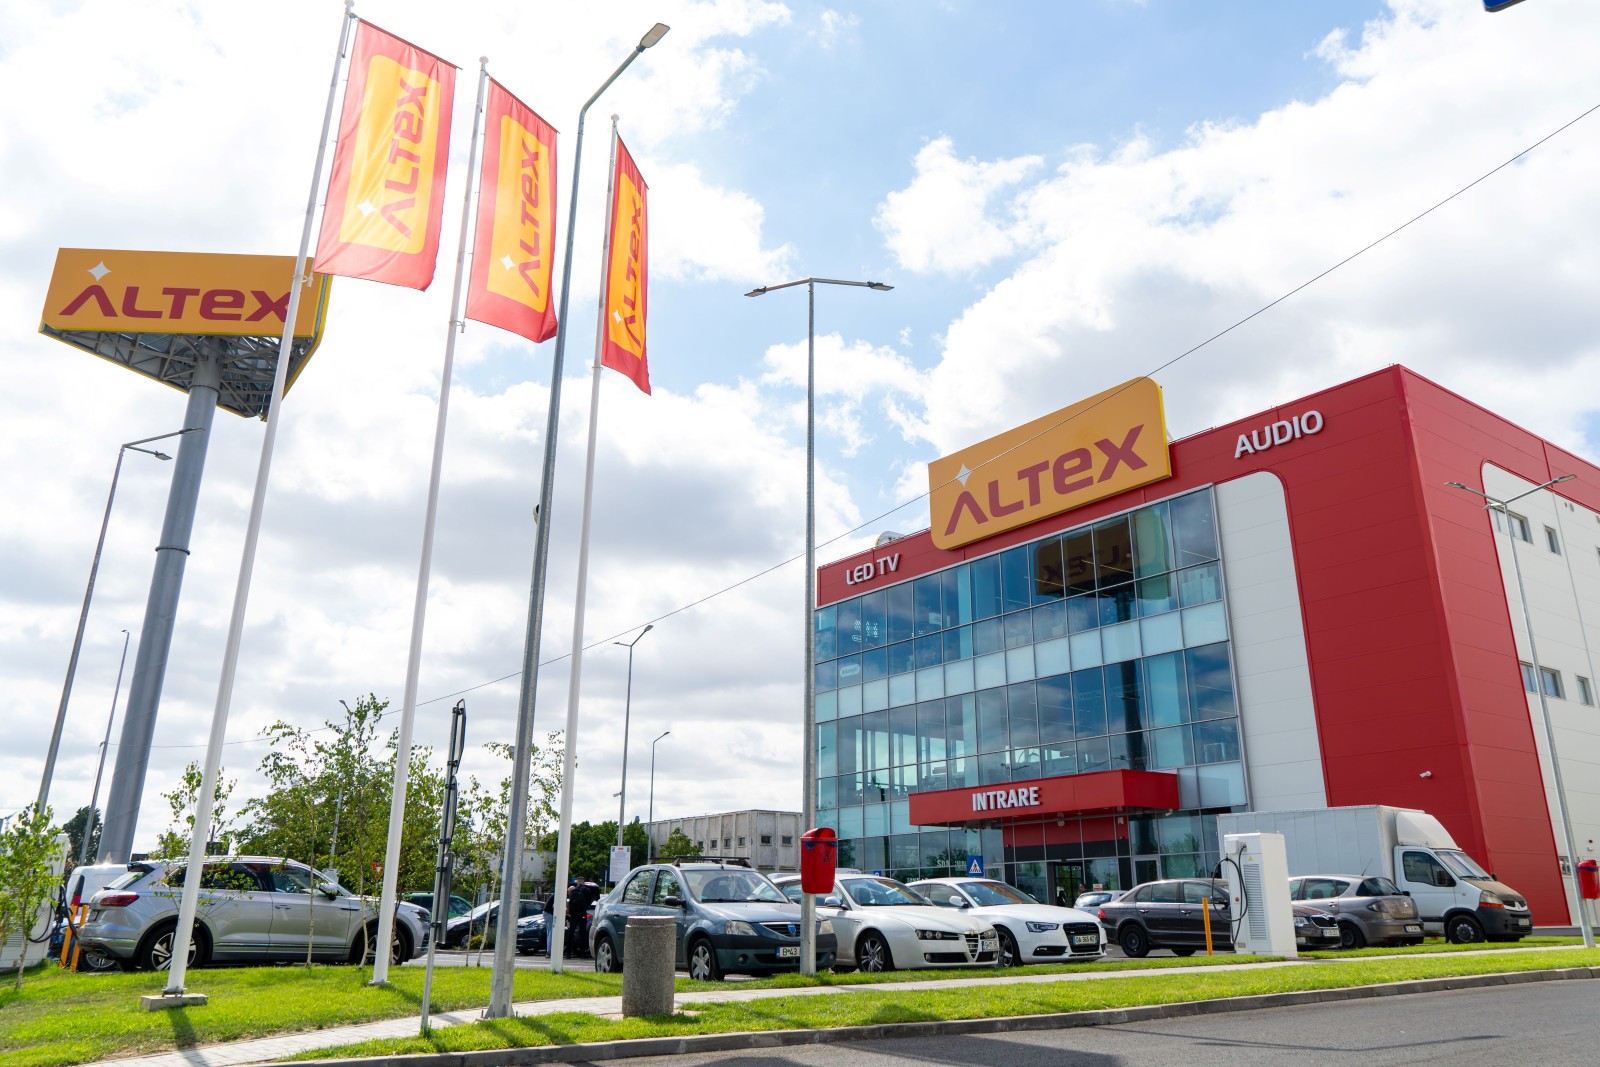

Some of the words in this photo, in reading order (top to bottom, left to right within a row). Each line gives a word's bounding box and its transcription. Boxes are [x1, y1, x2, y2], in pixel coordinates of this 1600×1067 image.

[1233, 410, 1323, 459] AUDIO
[846, 562, 875, 585] LED
[876, 552, 900, 575] TV
[972, 786, 1040, 812] INTRARE
